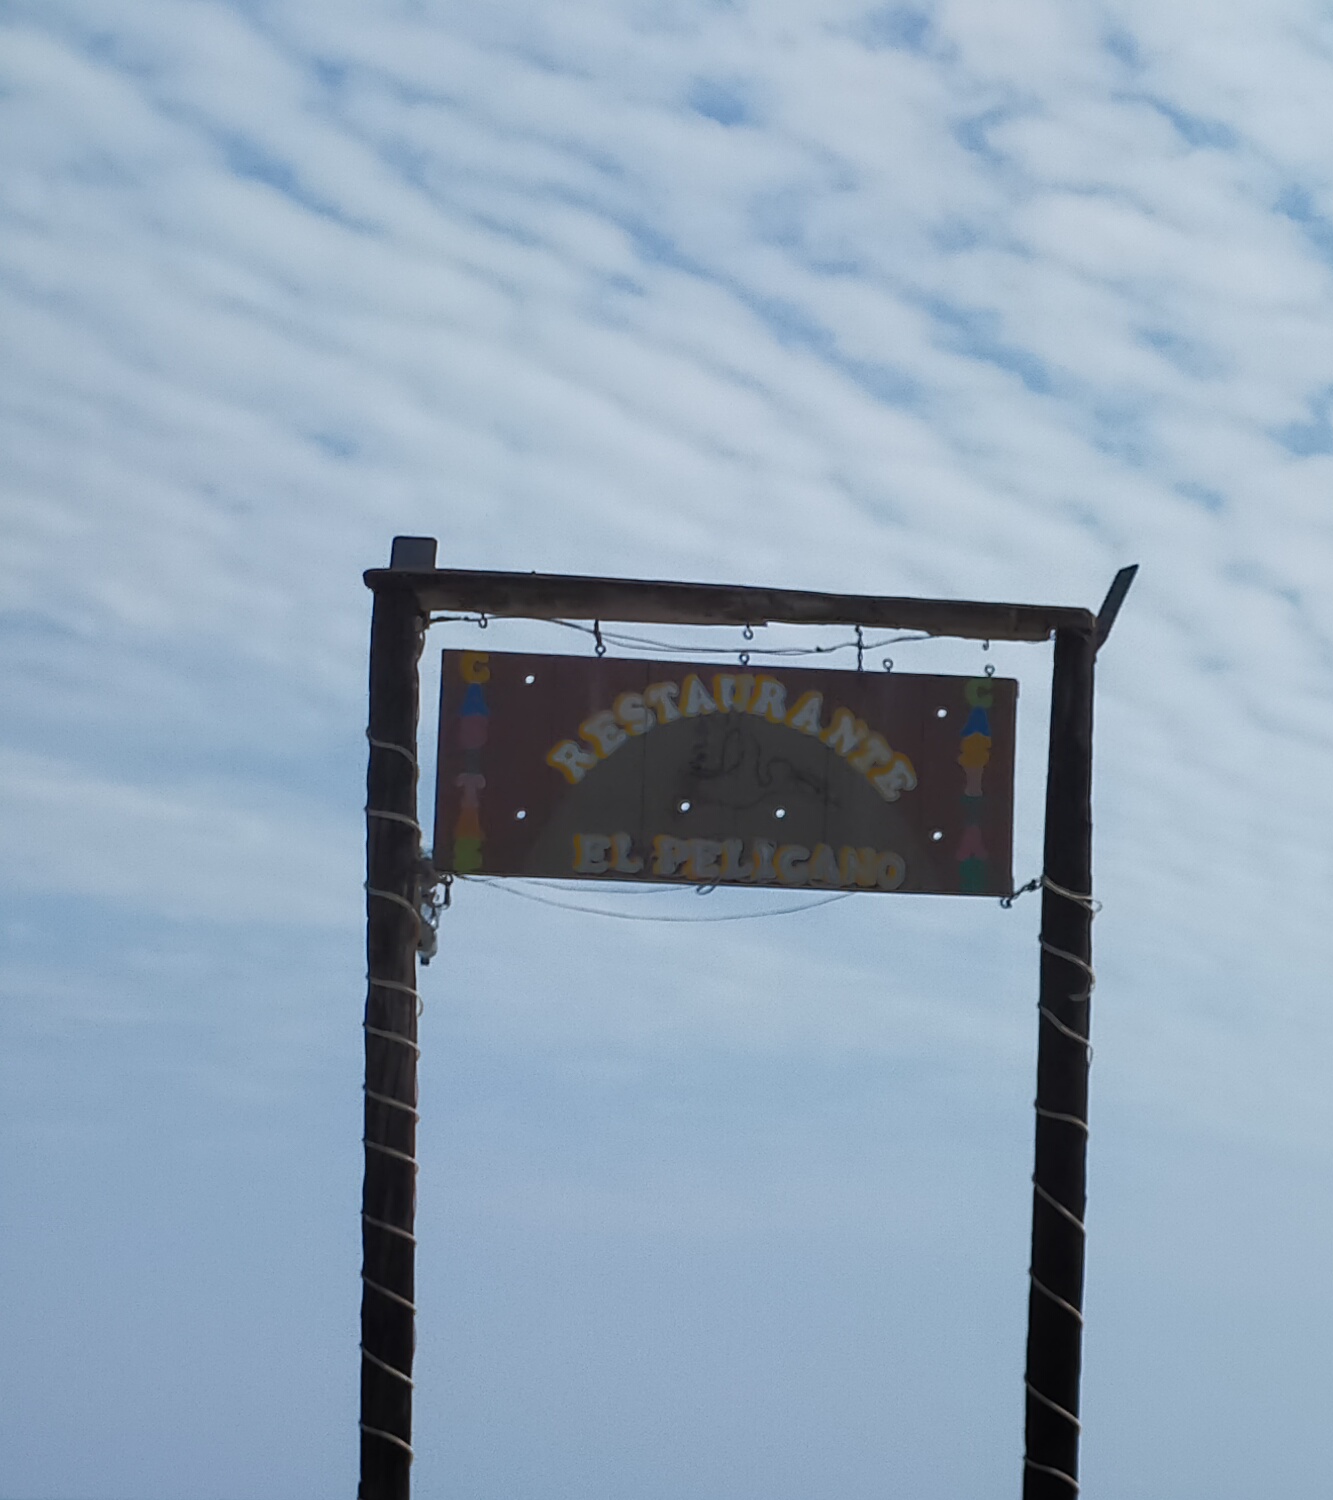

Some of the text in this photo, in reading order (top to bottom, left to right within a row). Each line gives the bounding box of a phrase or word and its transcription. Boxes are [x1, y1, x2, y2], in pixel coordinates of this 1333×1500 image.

[547, 674, 917, 802] RESTAURANTE
[573, 832, 906, 890] EL PELICANO
